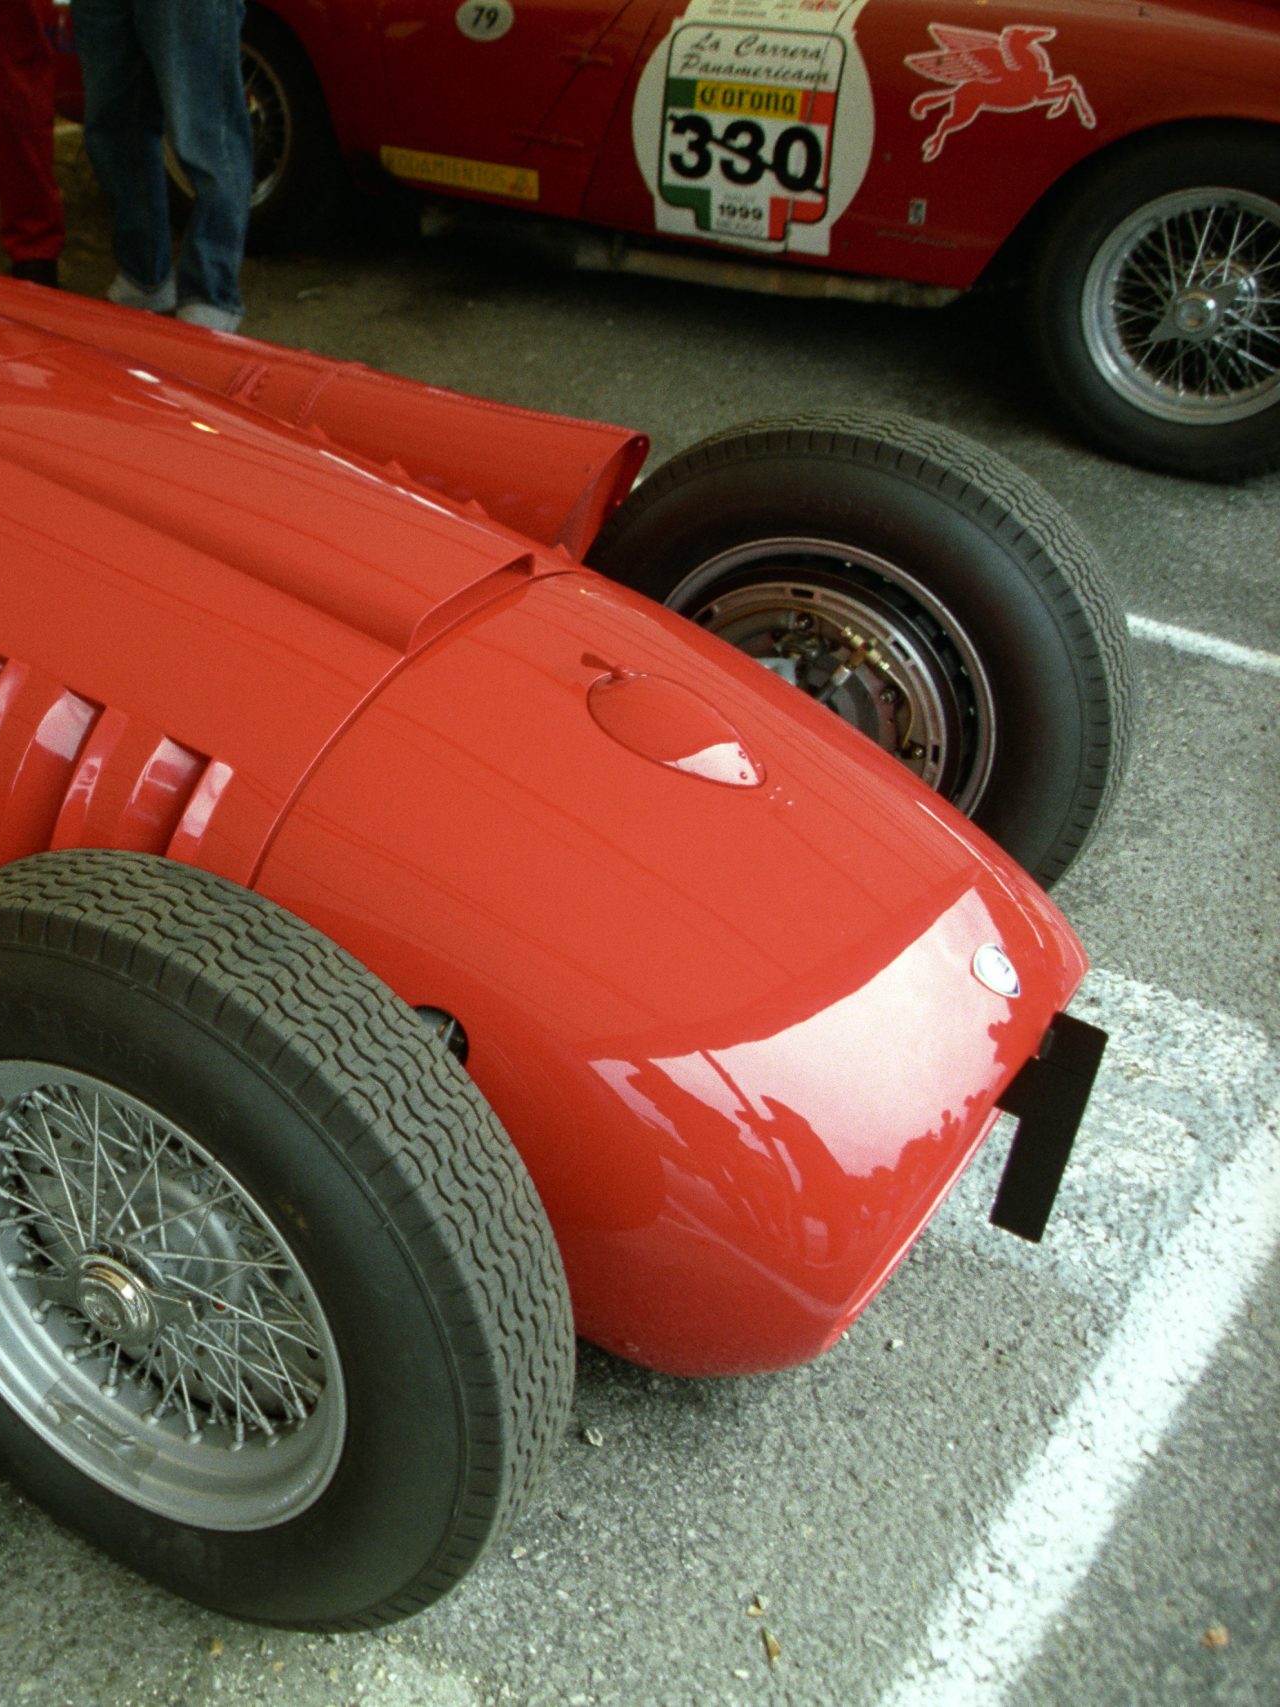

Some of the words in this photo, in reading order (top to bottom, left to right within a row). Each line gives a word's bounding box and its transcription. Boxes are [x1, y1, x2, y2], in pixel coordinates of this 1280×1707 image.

[471, 5, 499, 30] 79
[690, 31, 721, 51] La
[734, 34, 822, 61] Carrera
[679, 52, 829, 85] Panamericana
[699, 82, 797, 115] Corona
[669, 114, 824, 193] 330
[718, 203, 764, 221] 1999
